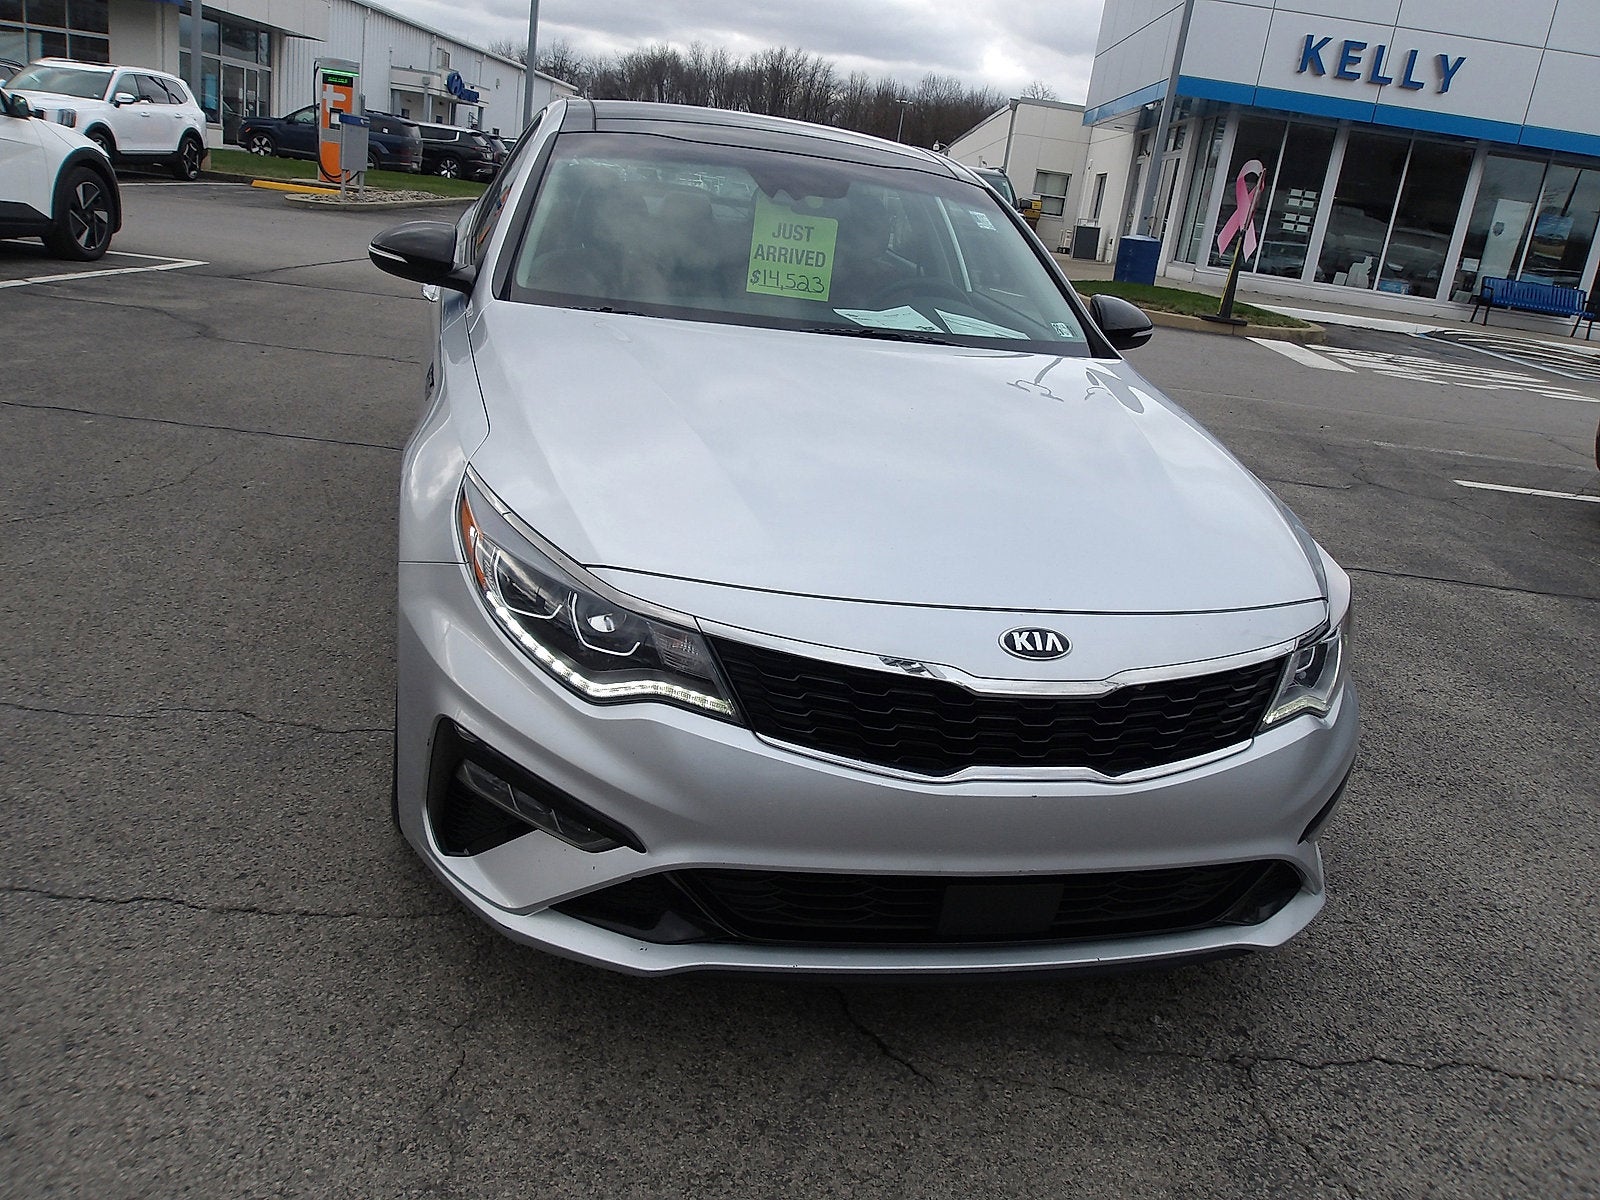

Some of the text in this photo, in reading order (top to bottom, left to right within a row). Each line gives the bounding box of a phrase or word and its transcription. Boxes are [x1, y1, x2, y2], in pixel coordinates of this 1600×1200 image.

[1297, 34, 1467, 94] KELLY
[772, 223, 815, 242] JUST
[753, 243, 826, 268] ARRIVED
[750, 269, 825, 294] $14,523
[1011, 631, 1064, 652] KIA
